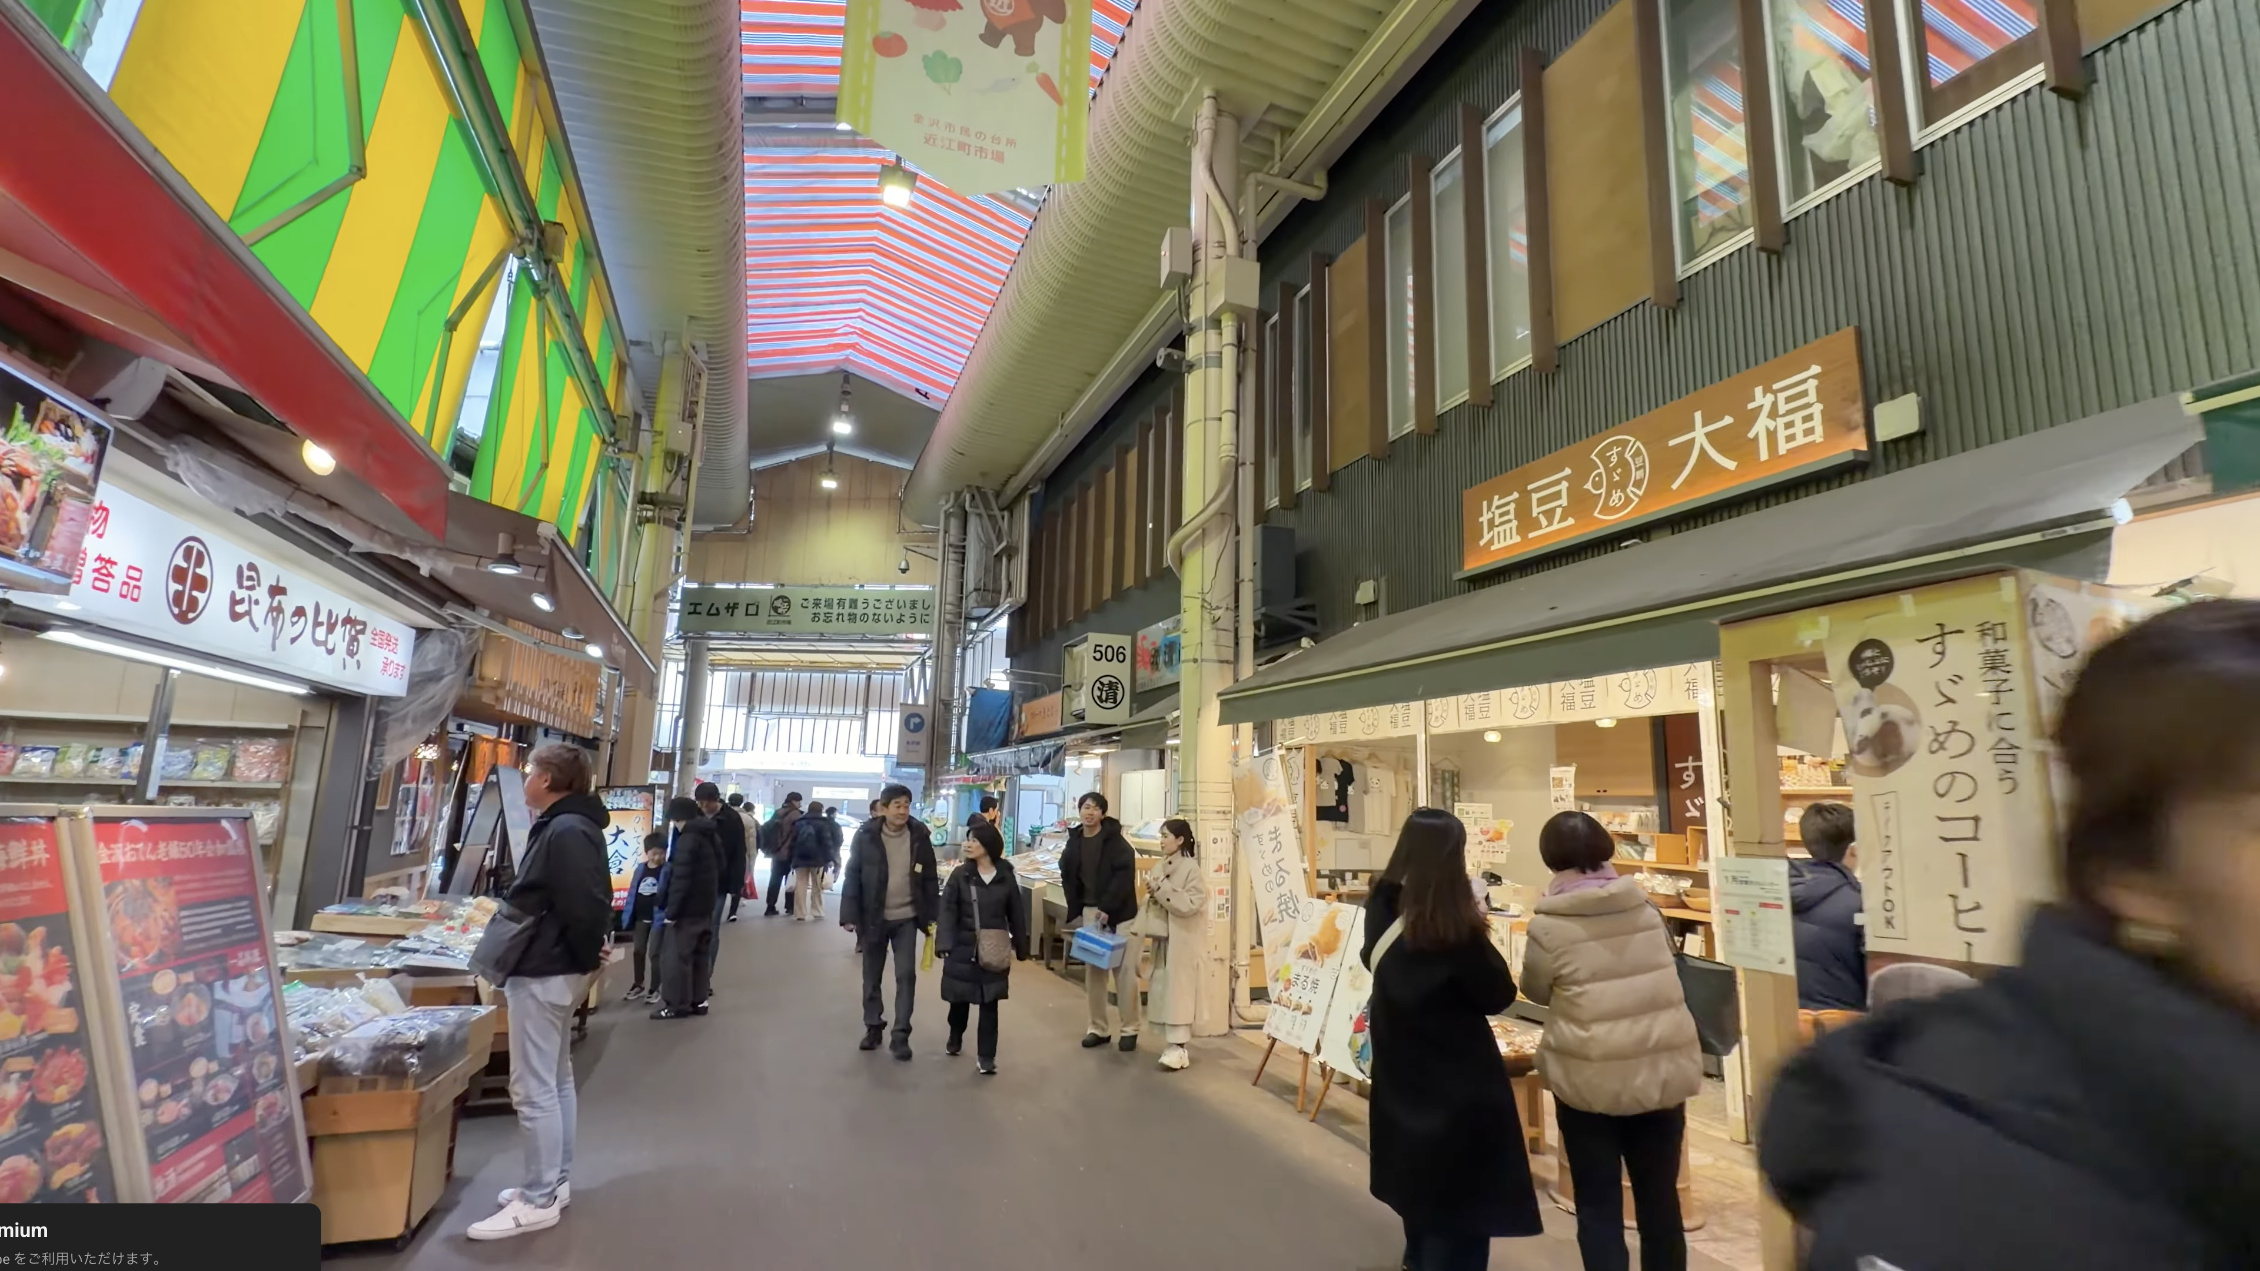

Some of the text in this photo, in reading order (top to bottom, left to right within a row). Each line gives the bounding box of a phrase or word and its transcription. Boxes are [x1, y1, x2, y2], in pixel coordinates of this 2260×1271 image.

[913, 112, 1017, 149] 金沢市民の台所
[923, 131, 1006, 165] 近江町市場
[1478, 363, 1825, 552] 塩豆 大福
[228, 561, 368, 671] 昆布の比賀
[800, 597, 935, 610] ご来場有難うございまし
[810, 612, 930, 624] お忘れ物のないように
[1092, 643, 1127, 664] 506
[1975, 620, 2022, 795] 和菓子に合う
